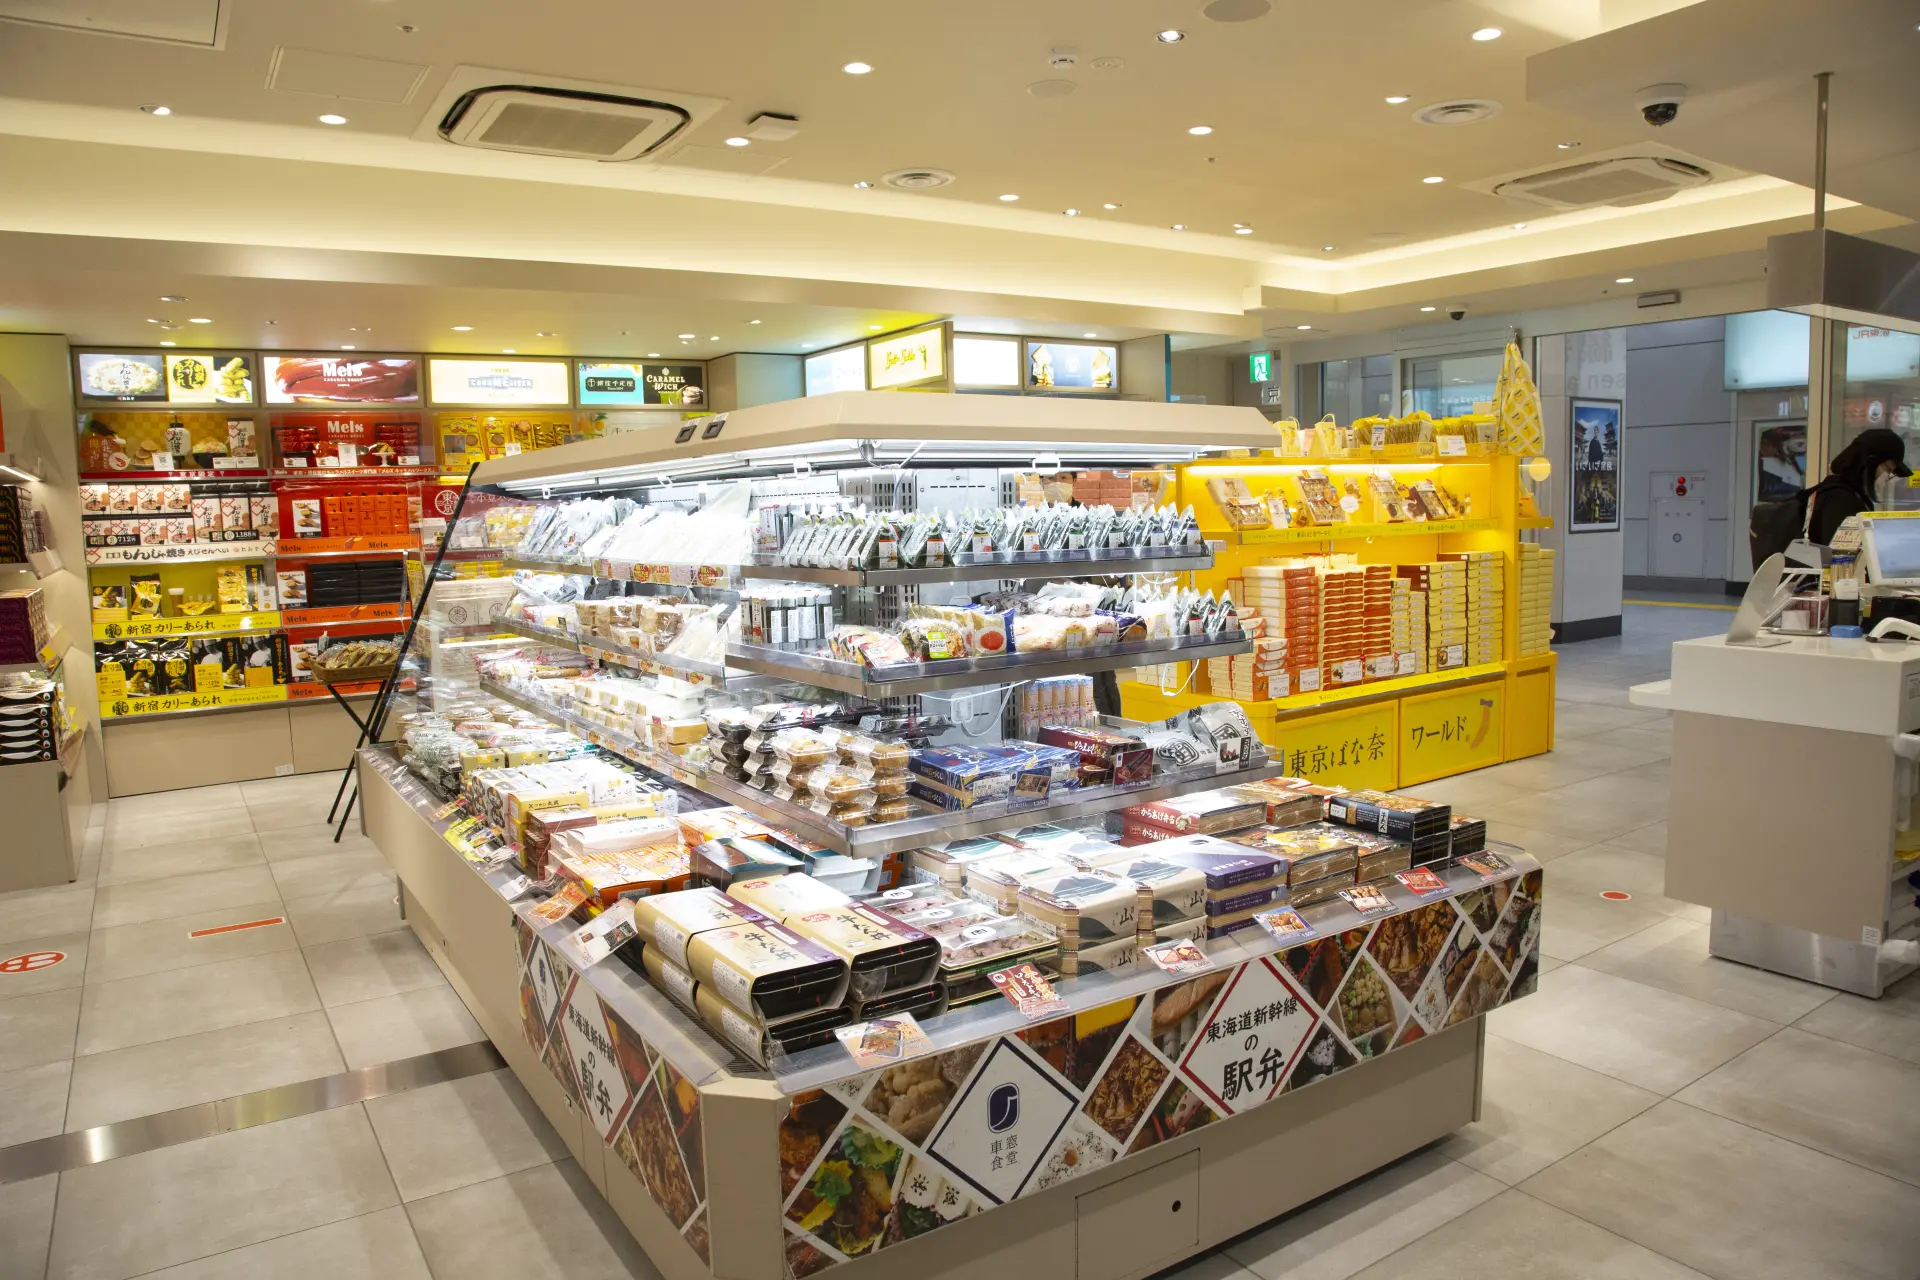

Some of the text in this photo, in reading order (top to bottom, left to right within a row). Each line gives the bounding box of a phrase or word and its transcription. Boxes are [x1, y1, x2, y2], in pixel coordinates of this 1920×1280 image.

[323, 363, 363, 377] Mels
[646, 374, 686, 383] CARAMEL
[654, 382, 678, 391] WICH
[327, 420, 364, 433] Mels
[122, 547, 186, 560] もんじゃ焼き
[1412, 716, 1467, 750] ワールド
[1289, 732, 1386, 778] 東京ばな奈
[1141, 807, 1176, 825] からあげ弁当
[1206, 997, 1299, 1044] 東海道新幹線
[568, 1003, 617, 1068] 東海道新幹線
[1244, 1033, 1259, 1051] の
[588, 1051, 596, 1069] の
[1221, 1046, 1286, 1101] 駅弁
[580, 1058, 613, 1125] 駅弁
[990, 1134, 1018, 1155] 車窓
[990, 1152, 1019, 1172] 食堂
